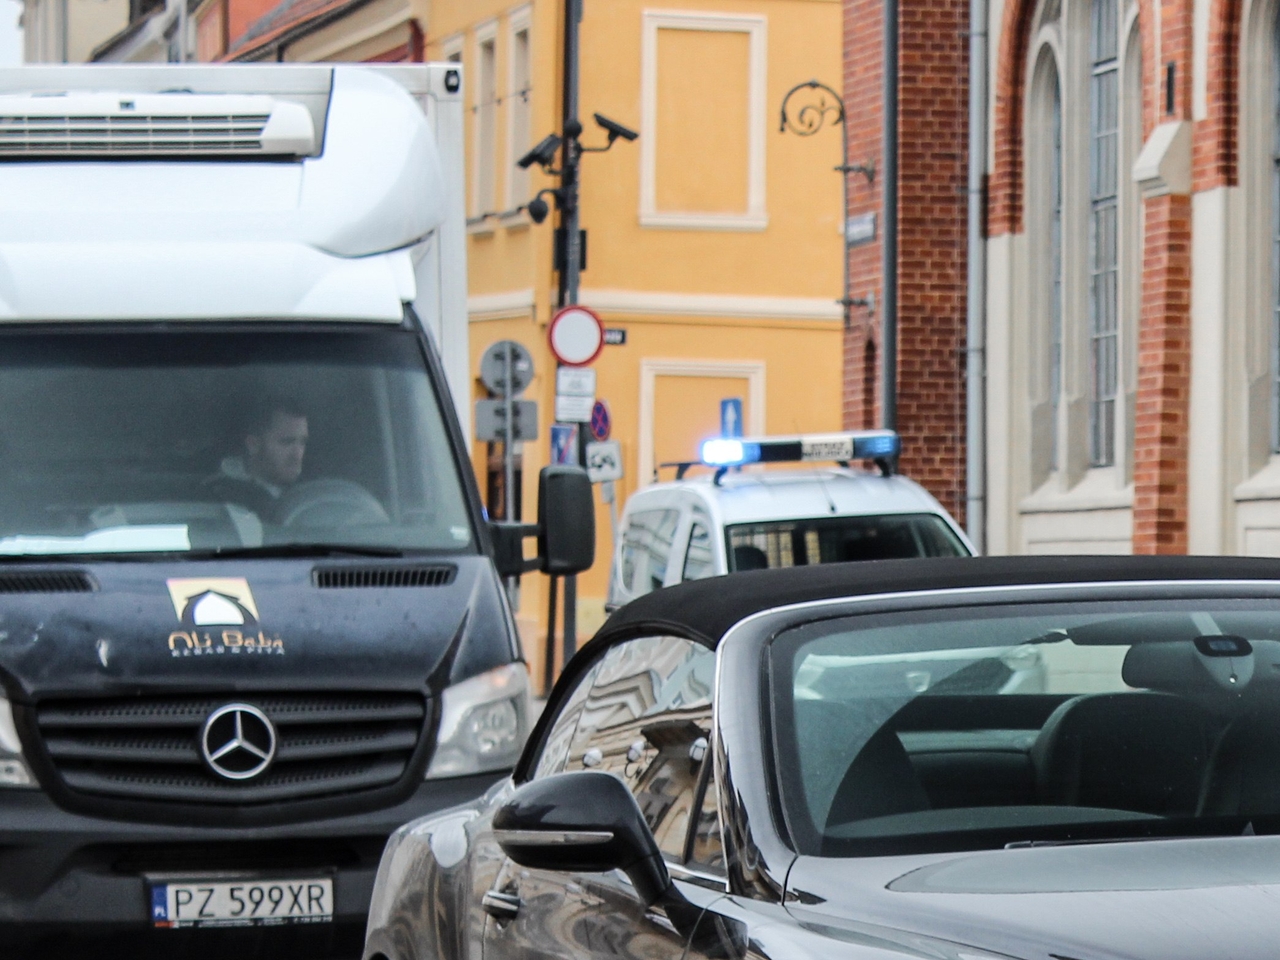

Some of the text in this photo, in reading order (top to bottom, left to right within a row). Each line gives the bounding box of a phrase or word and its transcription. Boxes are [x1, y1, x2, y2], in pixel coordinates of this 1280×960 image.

[155, 906, 167, 918] PL
[175, 884, 325, 918] PZ 599XR
